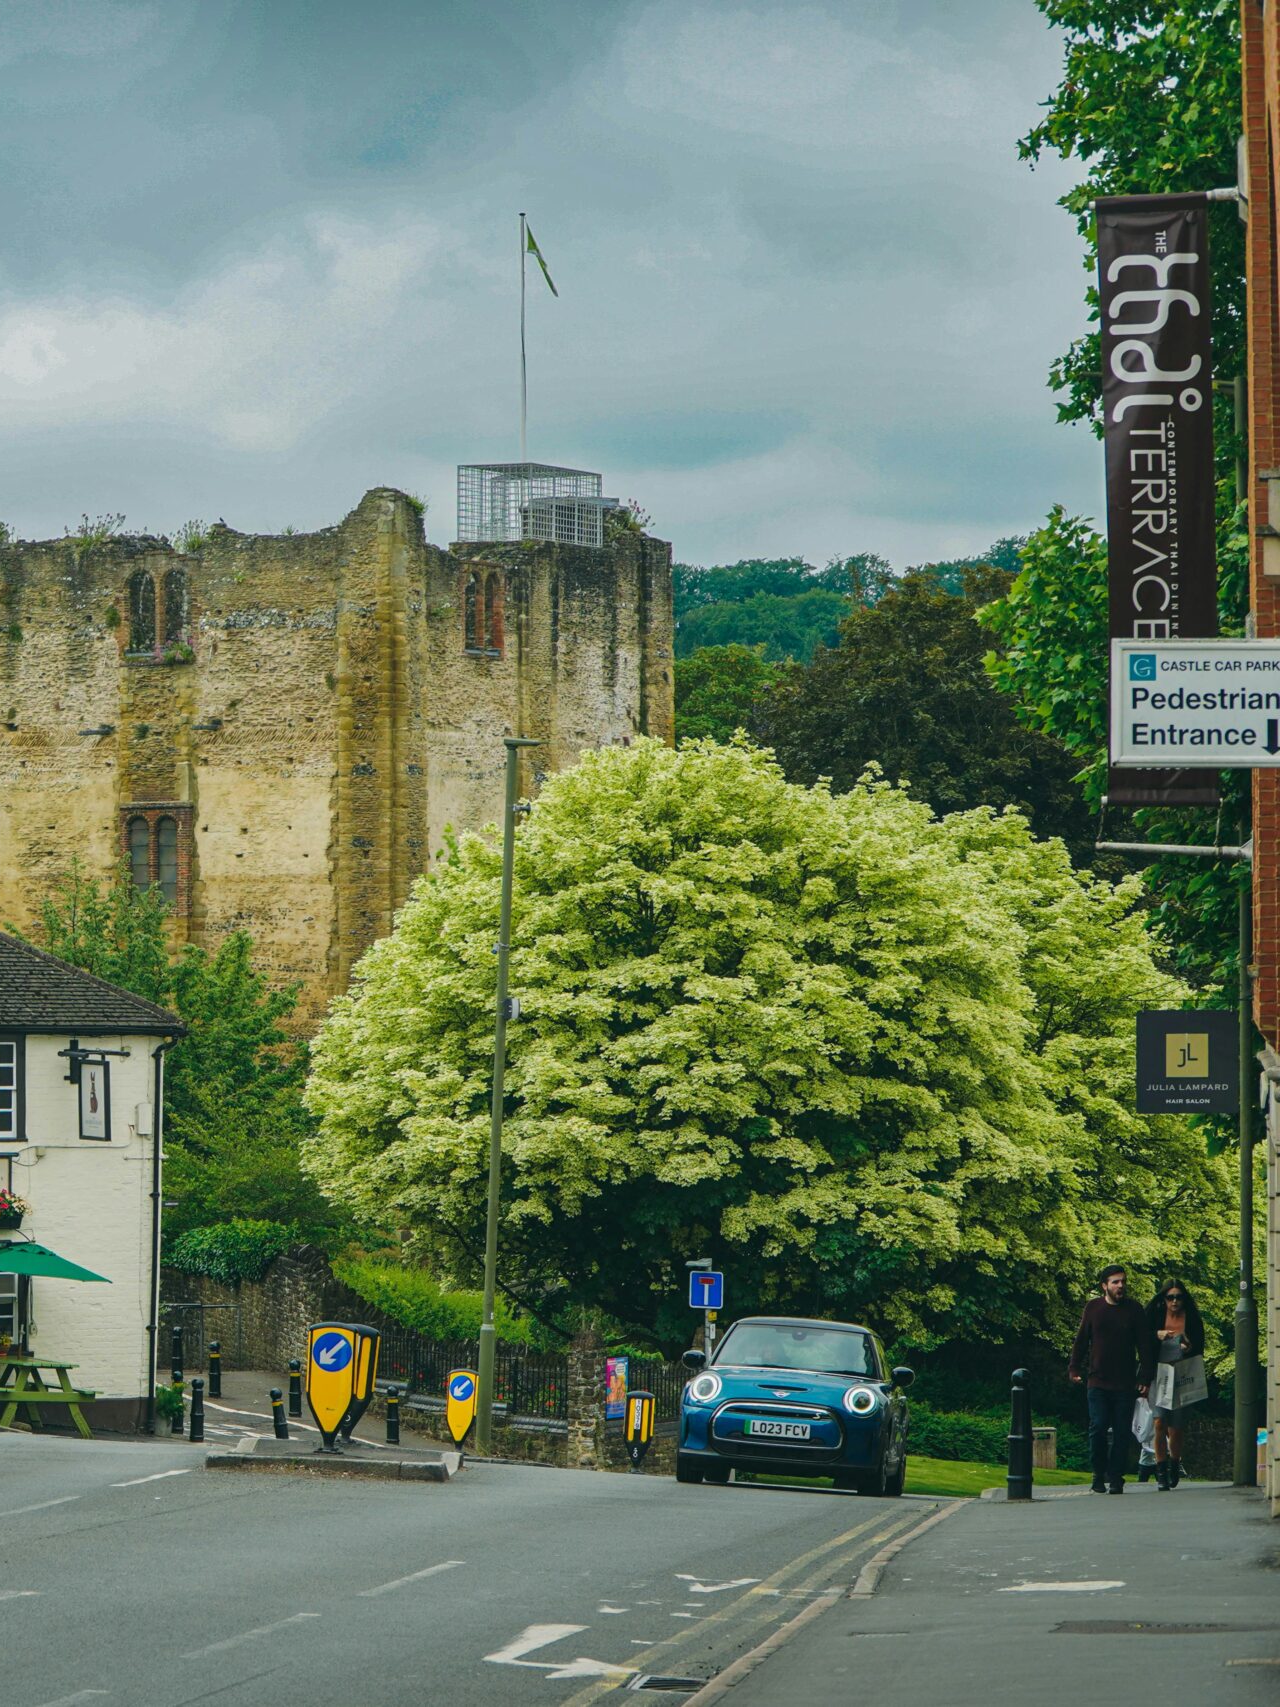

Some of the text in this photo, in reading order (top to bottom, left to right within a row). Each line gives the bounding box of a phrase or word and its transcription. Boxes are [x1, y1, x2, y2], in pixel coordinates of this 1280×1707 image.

[1155, 230, 1167, 253] THE
[1166, 421, 1179, 535] CONTEMPORARY
[1129, 421, 1170, 639] TERRACE
[1169, 542, 1179, 576] THAI
[1160, 661, 1280, 672] CASTLE CAR PARK
[1132, 687, 1280, 710] Pedestrian
[1132, 723, 1257, 746] Entrance
[1146, 1083, 1229, 1091] JULIA LAMPARD
[752, 1422, 809, 1437] LO23 FCV
